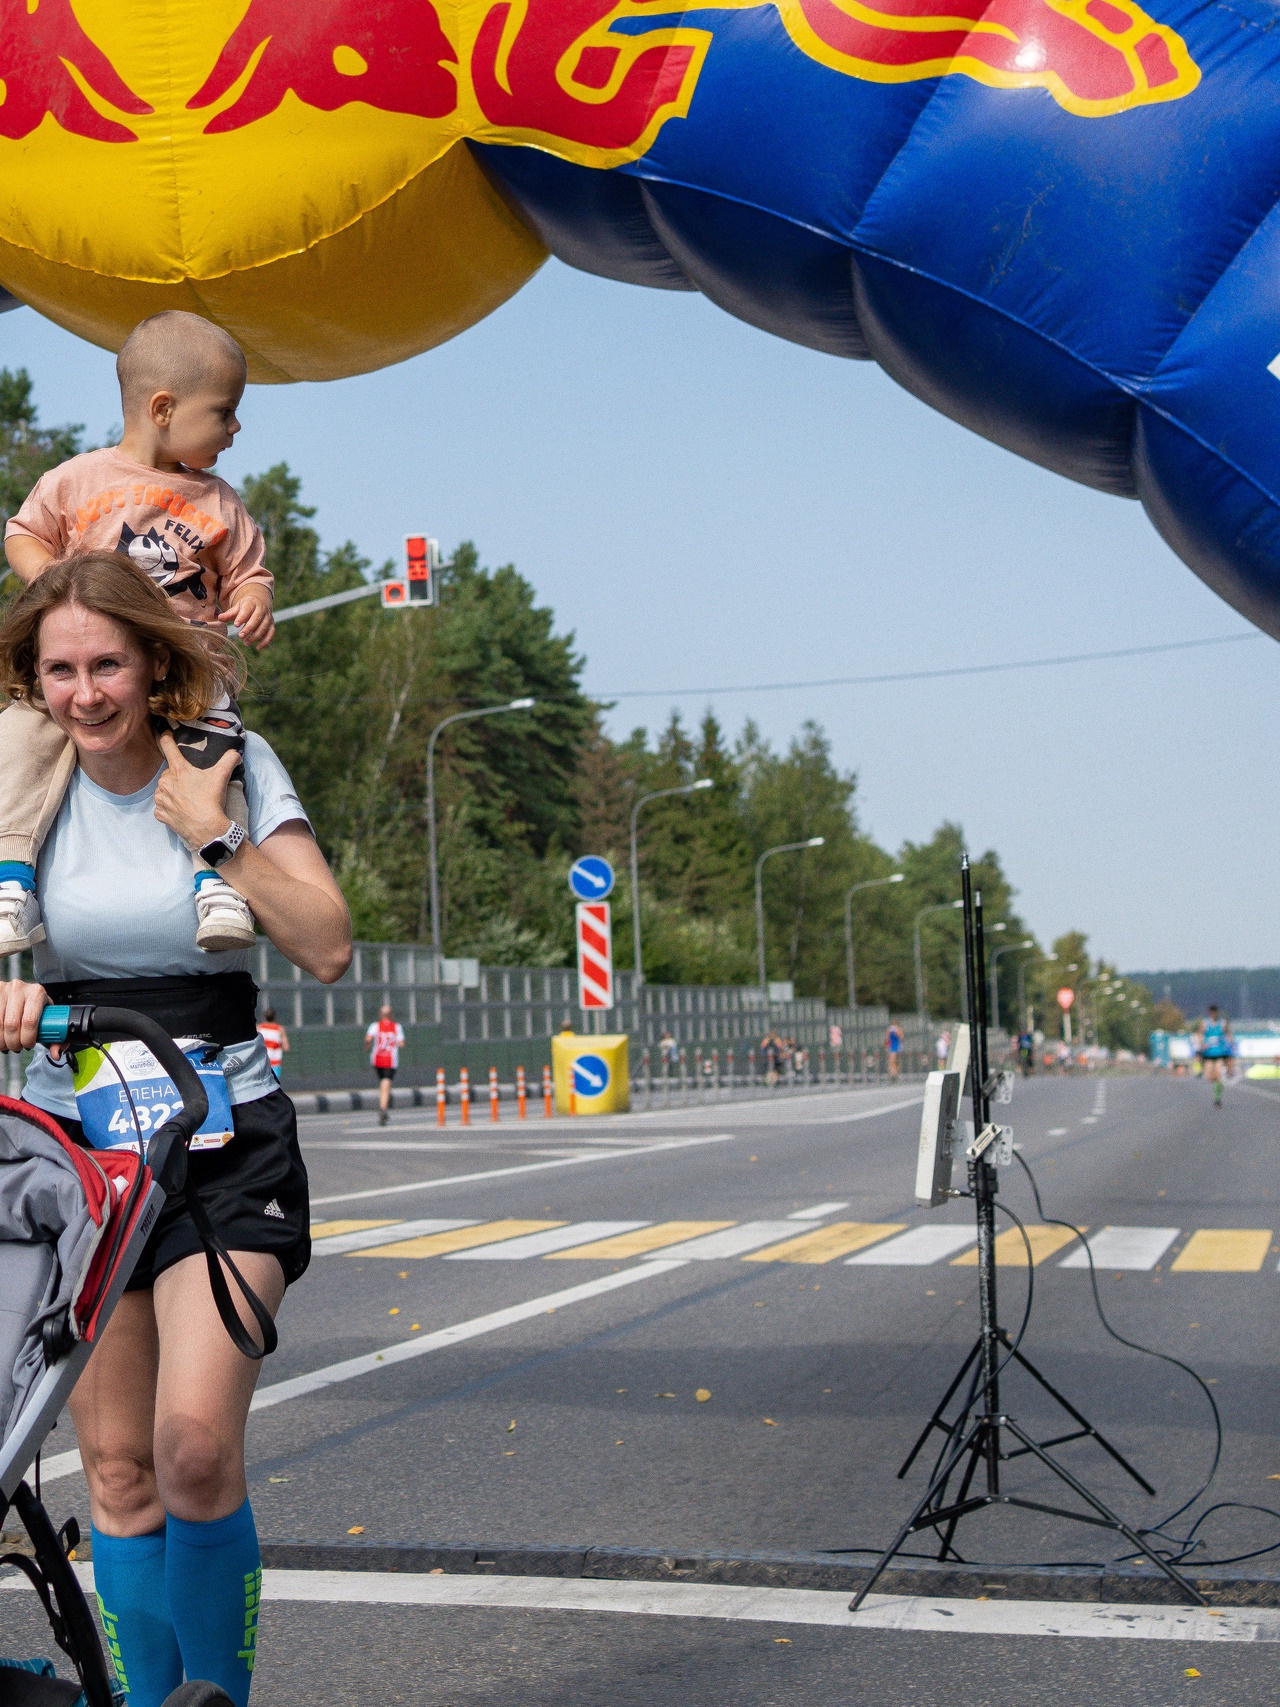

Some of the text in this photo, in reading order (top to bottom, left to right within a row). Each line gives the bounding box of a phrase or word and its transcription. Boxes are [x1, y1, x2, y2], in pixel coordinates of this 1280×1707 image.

[76, 487, 126, 540] APPY
[164, 519, 205, 554] FELIX
[118, 1084, 176, 1102] ЕЛЕНА
[264, 1208, 285, 1219] adidas
